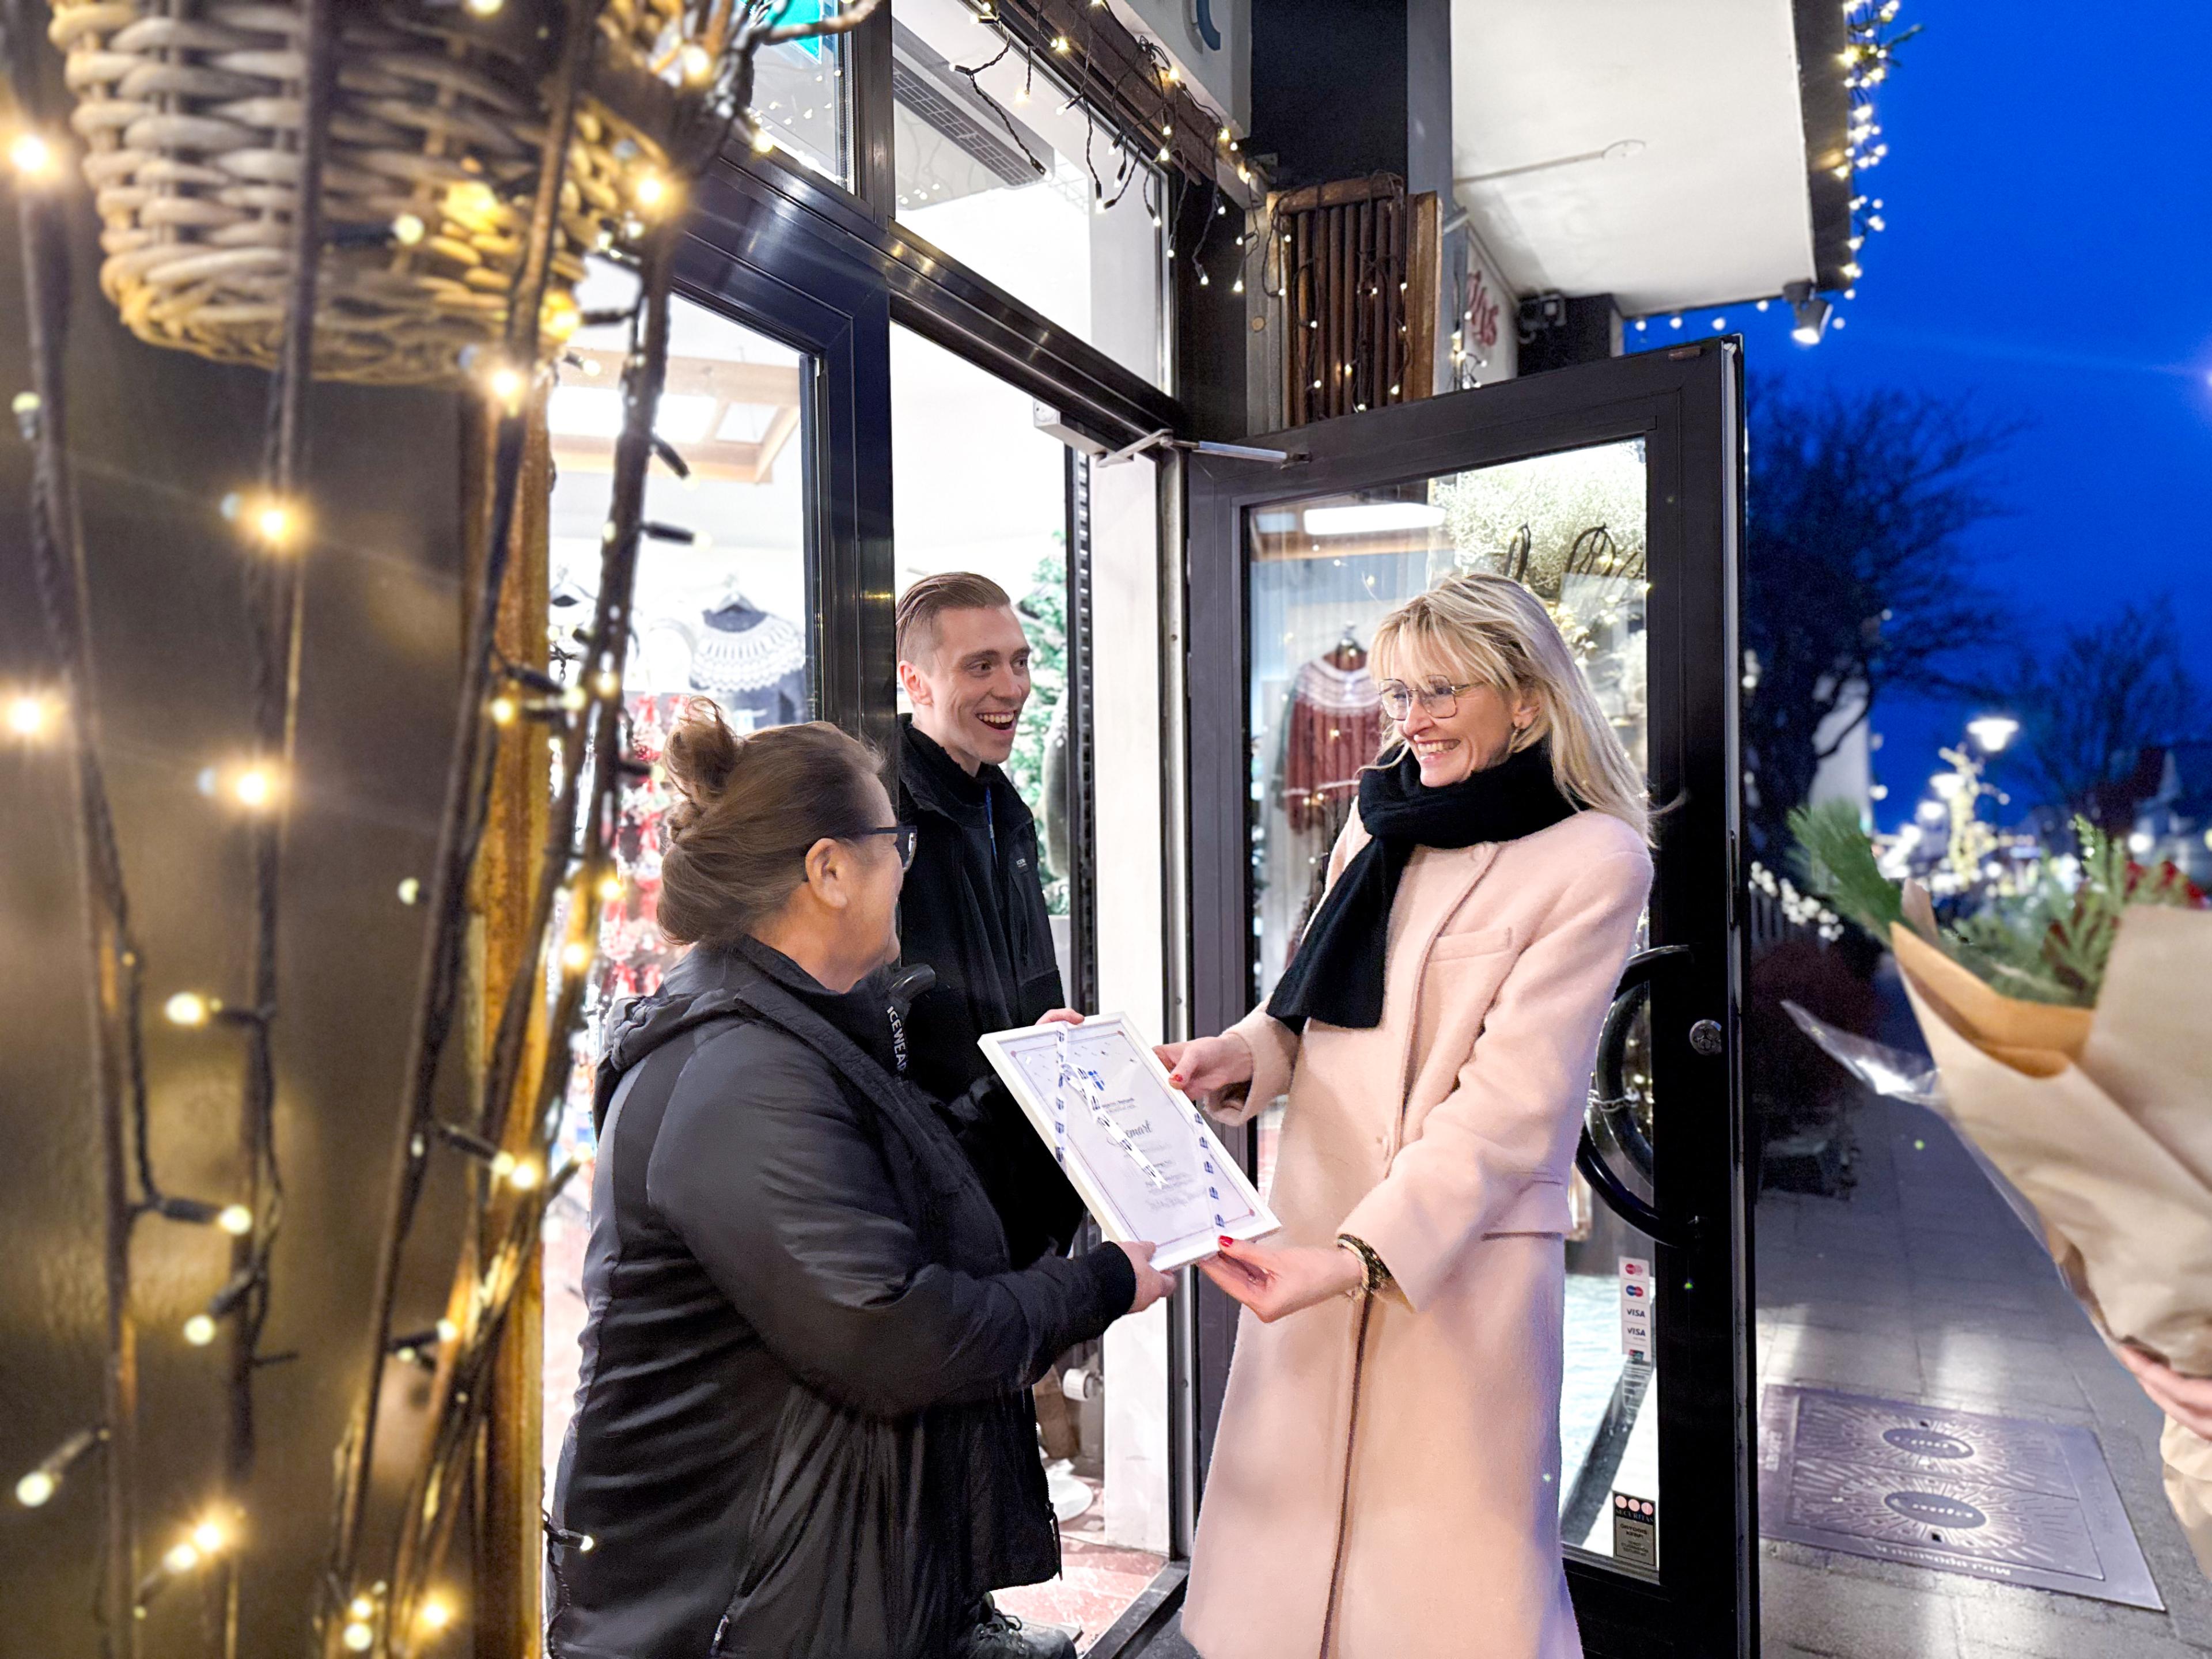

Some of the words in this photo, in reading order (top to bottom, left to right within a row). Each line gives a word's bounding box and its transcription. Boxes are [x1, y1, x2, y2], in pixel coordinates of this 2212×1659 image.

[1627, 1308, 1645, 1317] VISA
[1627, 1327, 1645, 1336] VISA
[1615, 1509, 1654, 1522] SECURITAS
